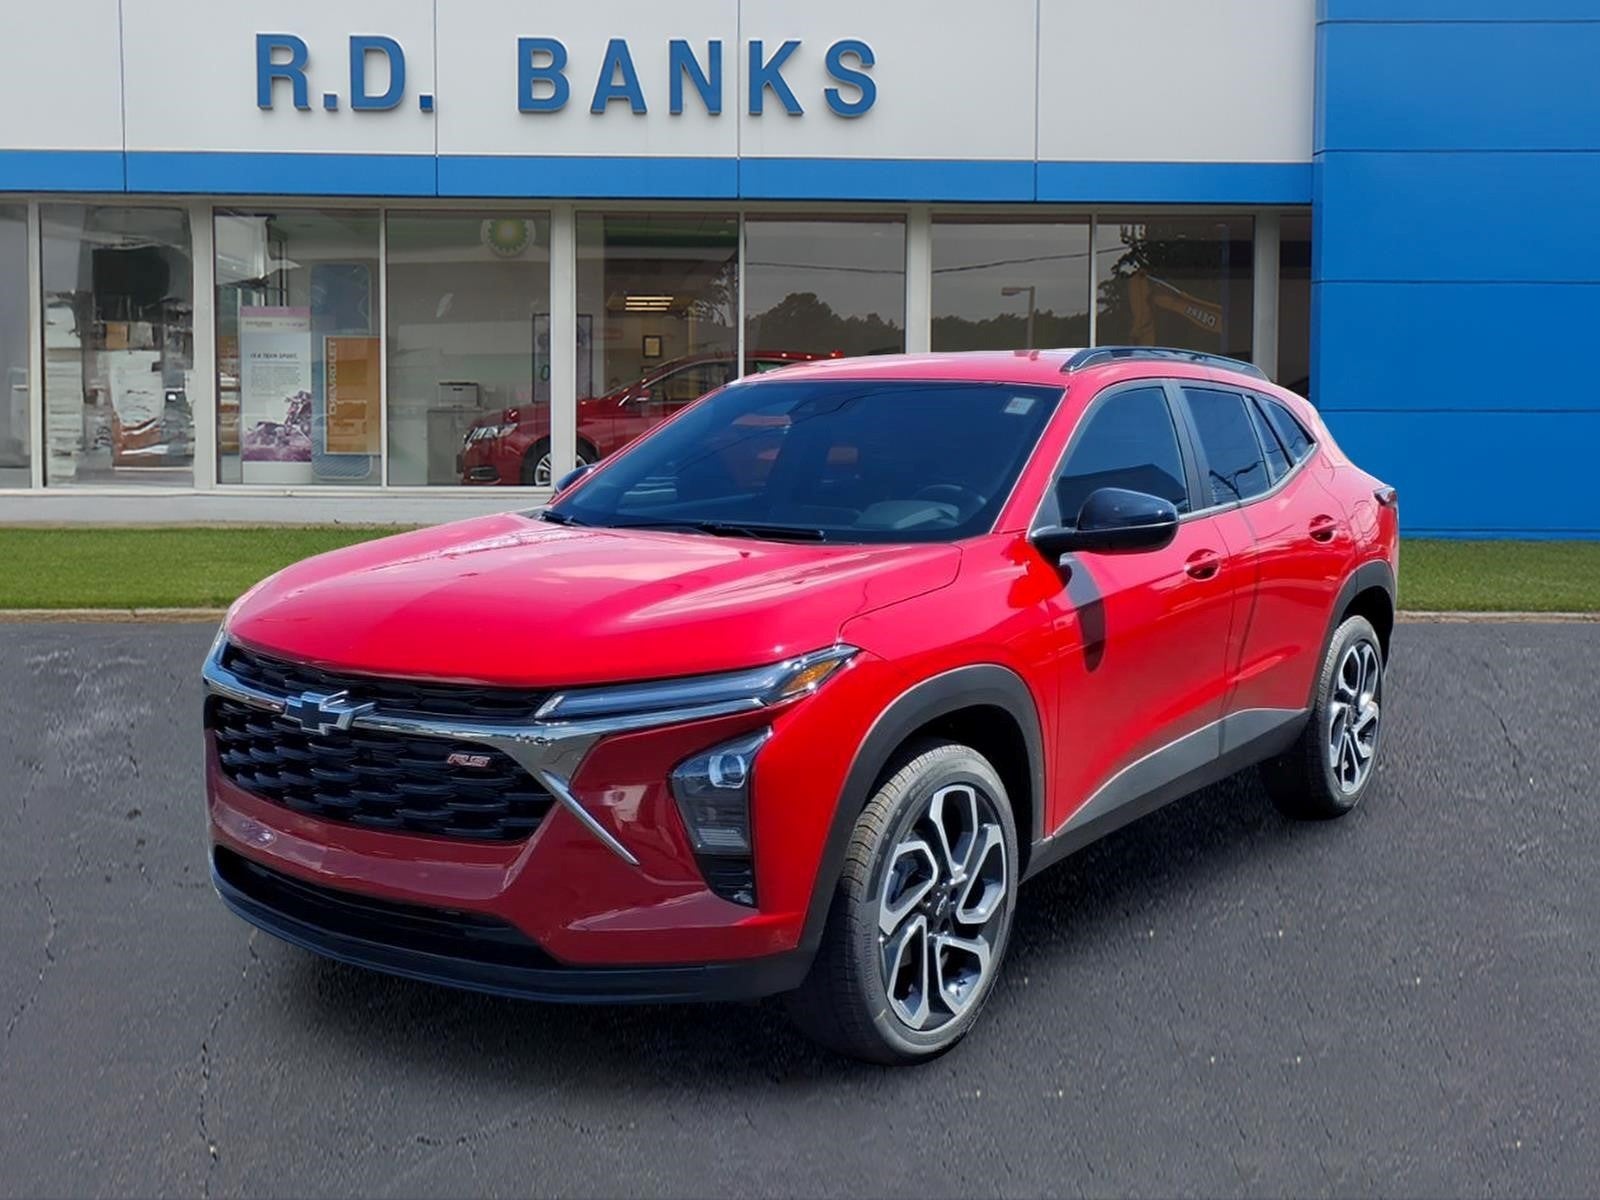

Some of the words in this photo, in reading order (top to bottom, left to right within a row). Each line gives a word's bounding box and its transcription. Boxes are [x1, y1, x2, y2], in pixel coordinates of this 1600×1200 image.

[256, 33, 434, 111] R.D.
[517, 37, 877, 117] BANKS
[448, 753, 491, 767] RS
